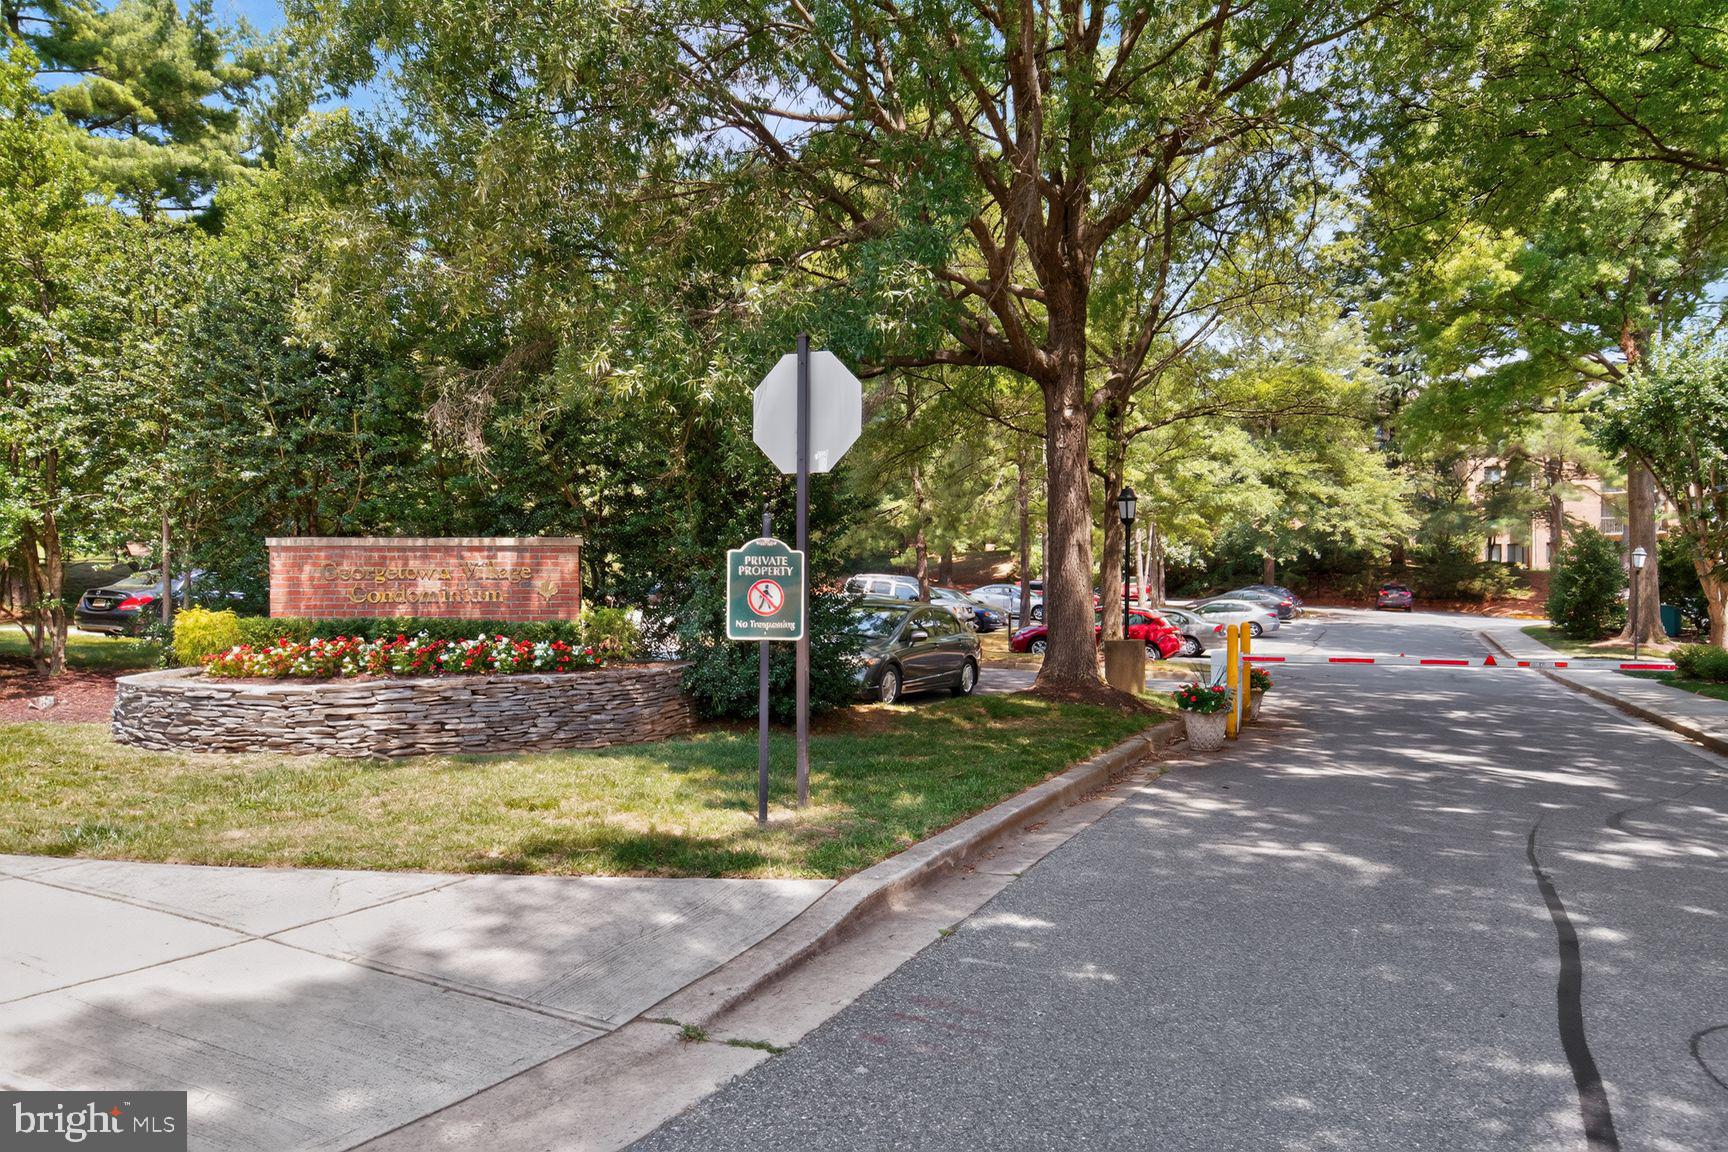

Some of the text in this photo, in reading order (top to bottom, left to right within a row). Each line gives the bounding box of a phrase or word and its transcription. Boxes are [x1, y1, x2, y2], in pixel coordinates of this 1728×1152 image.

[744, 556, 789, 566] PRIVATE
[320, 560, 533, 584] Georgetown Village
[738, 566, 794, 576] PROPERTY
[347, 580, 504, 604] Condominium
[735, 620, 749, 629] No
